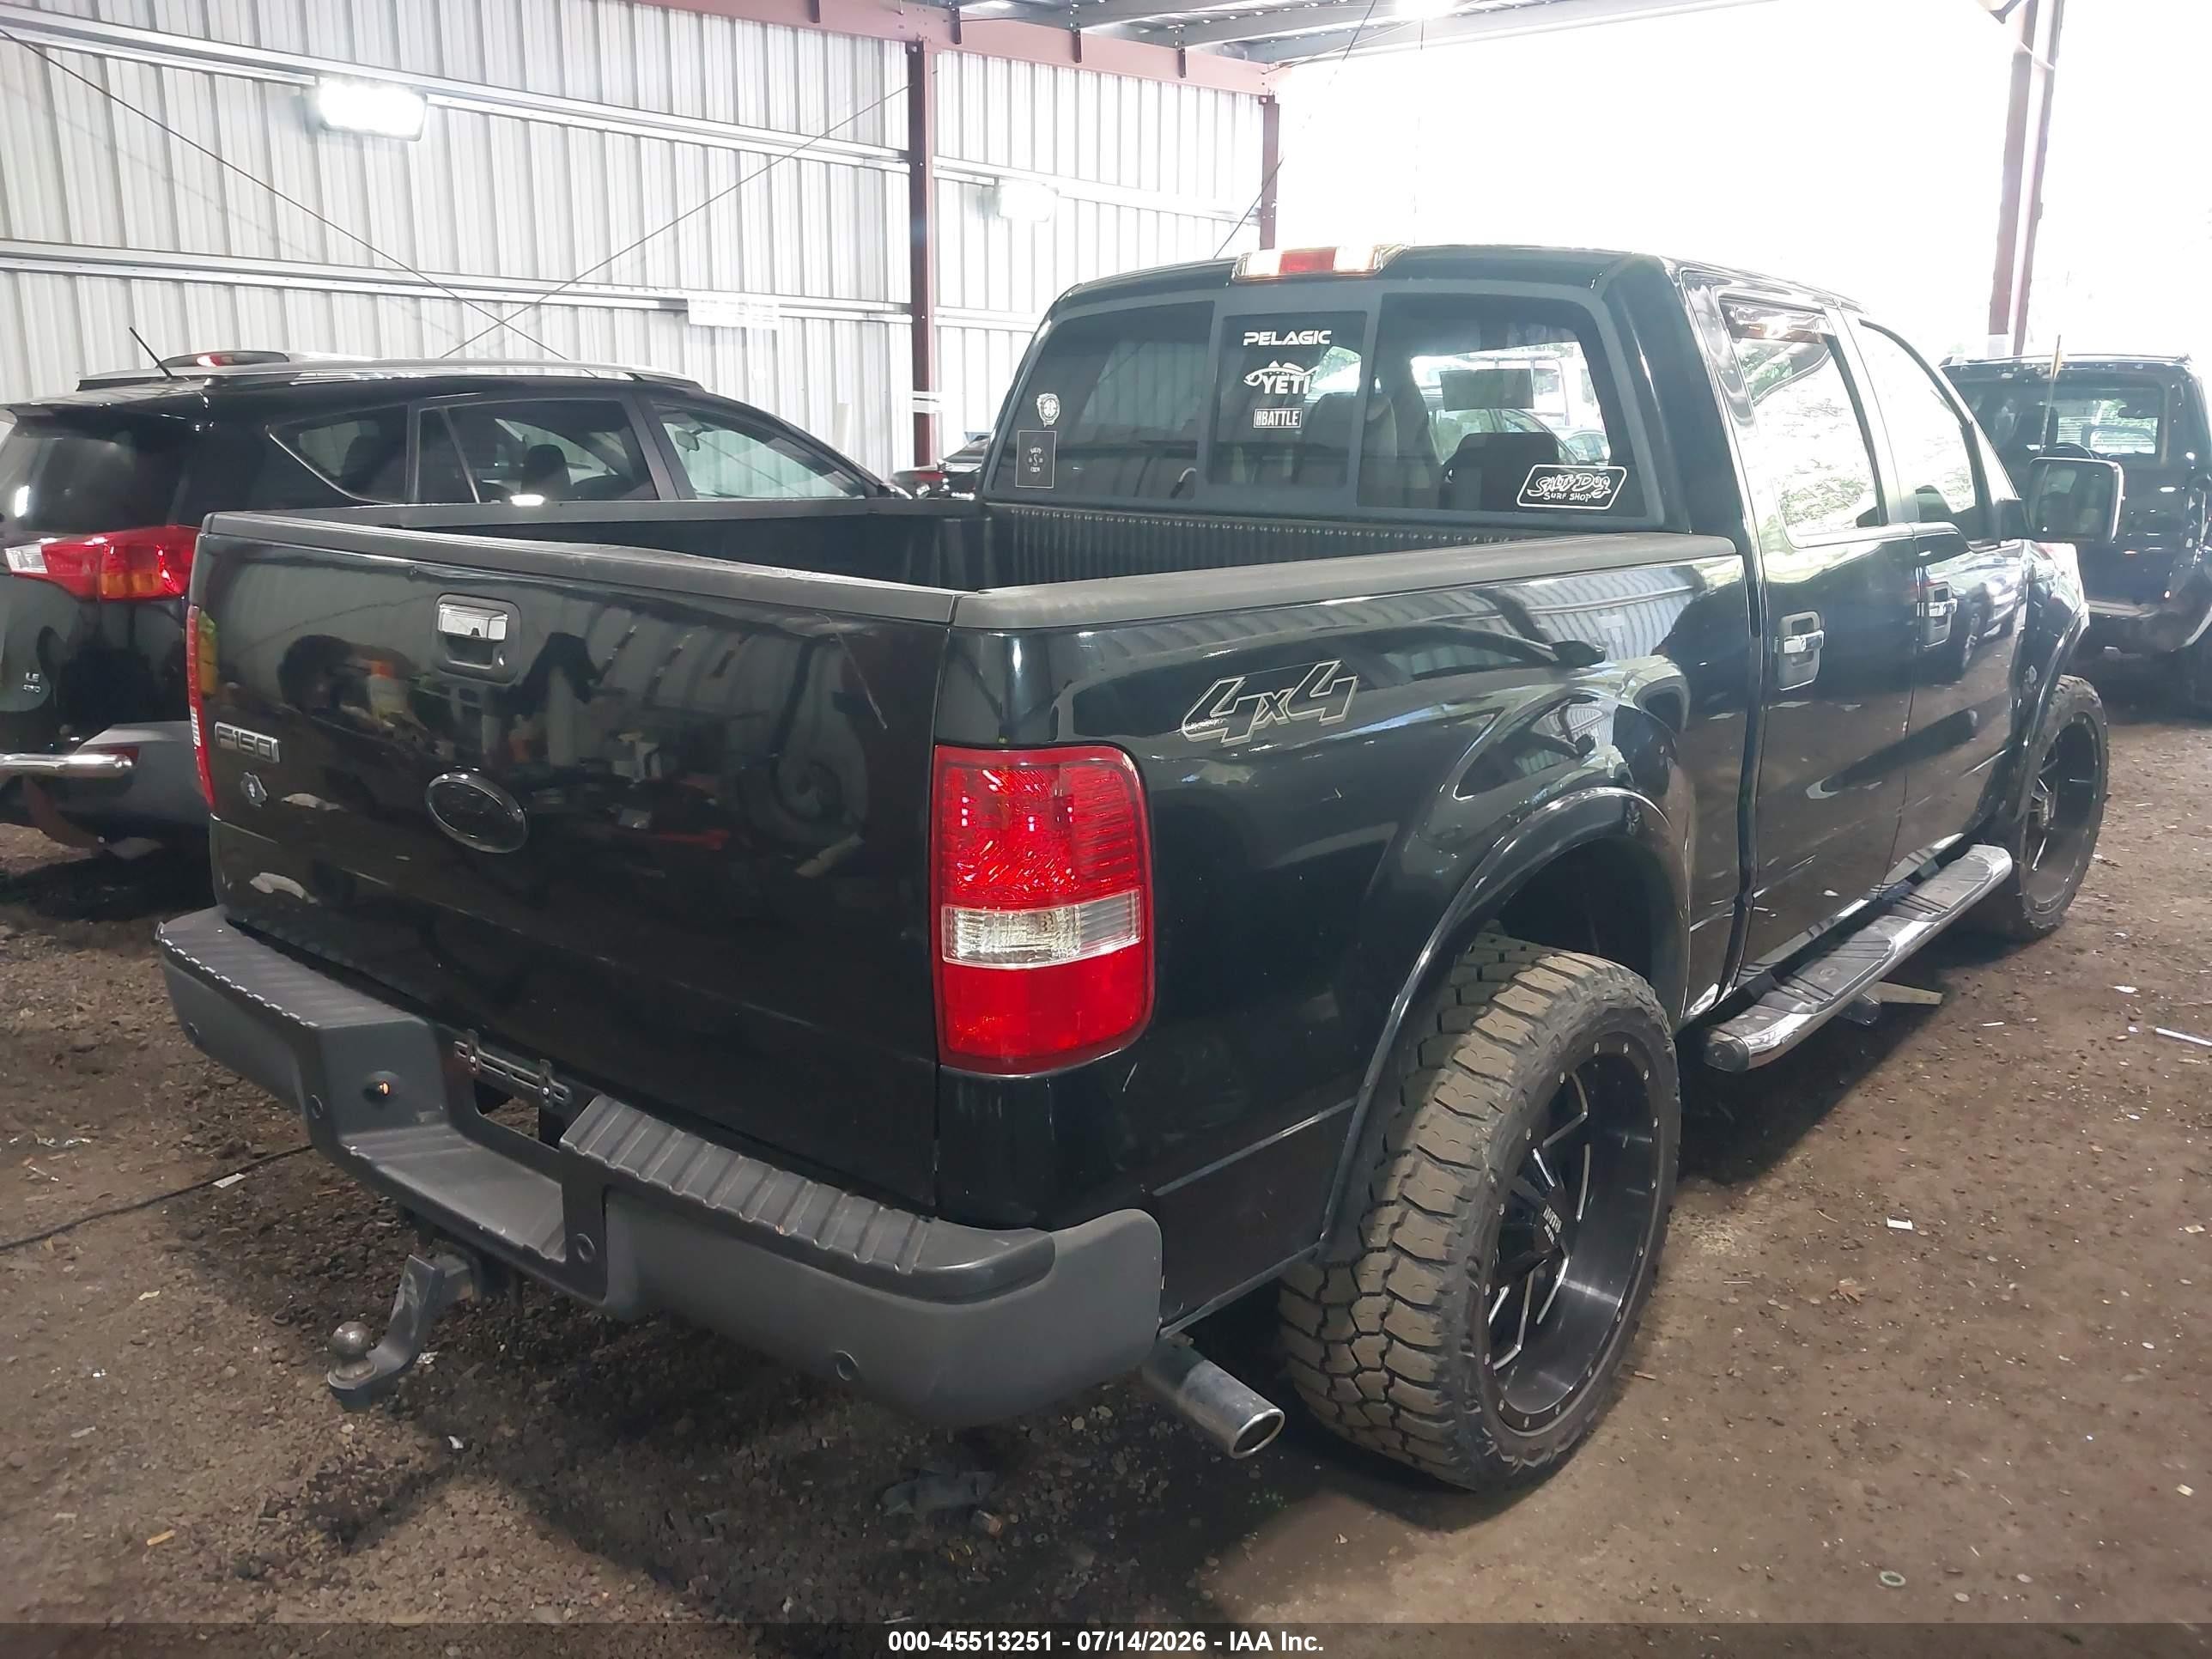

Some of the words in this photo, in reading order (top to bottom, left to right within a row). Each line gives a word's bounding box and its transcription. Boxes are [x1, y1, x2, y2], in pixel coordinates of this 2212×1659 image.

[1243, 330, 1332, 346] PELAGIC
[1262, 375, 1311, 394] YETI
[1261, 410, 1298, 426] BATTLE
[1569, 492, 1592, 502] SHOP
[26, 672, 40, 682] LE
[1182, 659, 1360, 747] 4x4
